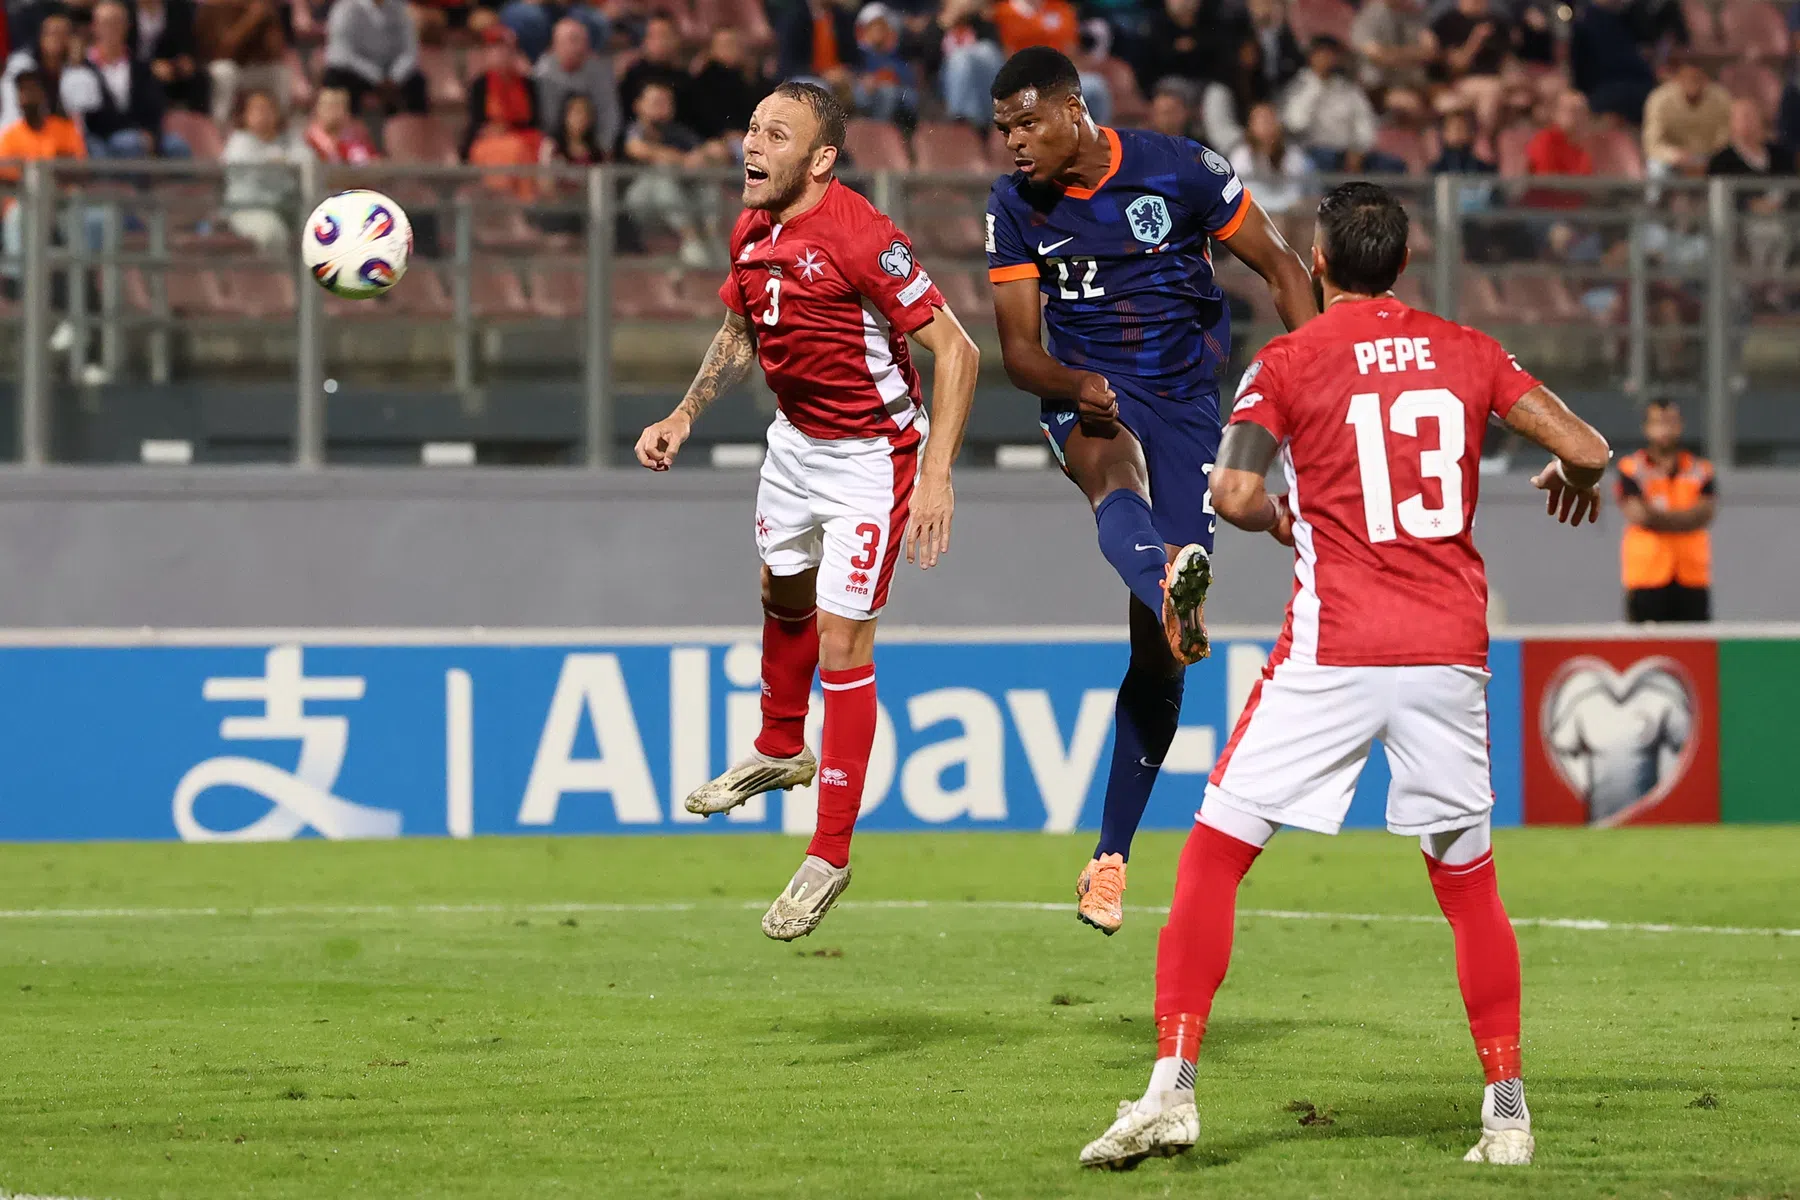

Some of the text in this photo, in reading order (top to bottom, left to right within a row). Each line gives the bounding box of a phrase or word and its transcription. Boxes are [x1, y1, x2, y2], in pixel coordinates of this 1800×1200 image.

[762, 277, 781, 327] 3
[1045, 255, 1106, 300] 22
[1352, 336, 1437, 376] PEPE
[1345, 387, 1466, 544] 13
[850, 522, 881, 571] 3
